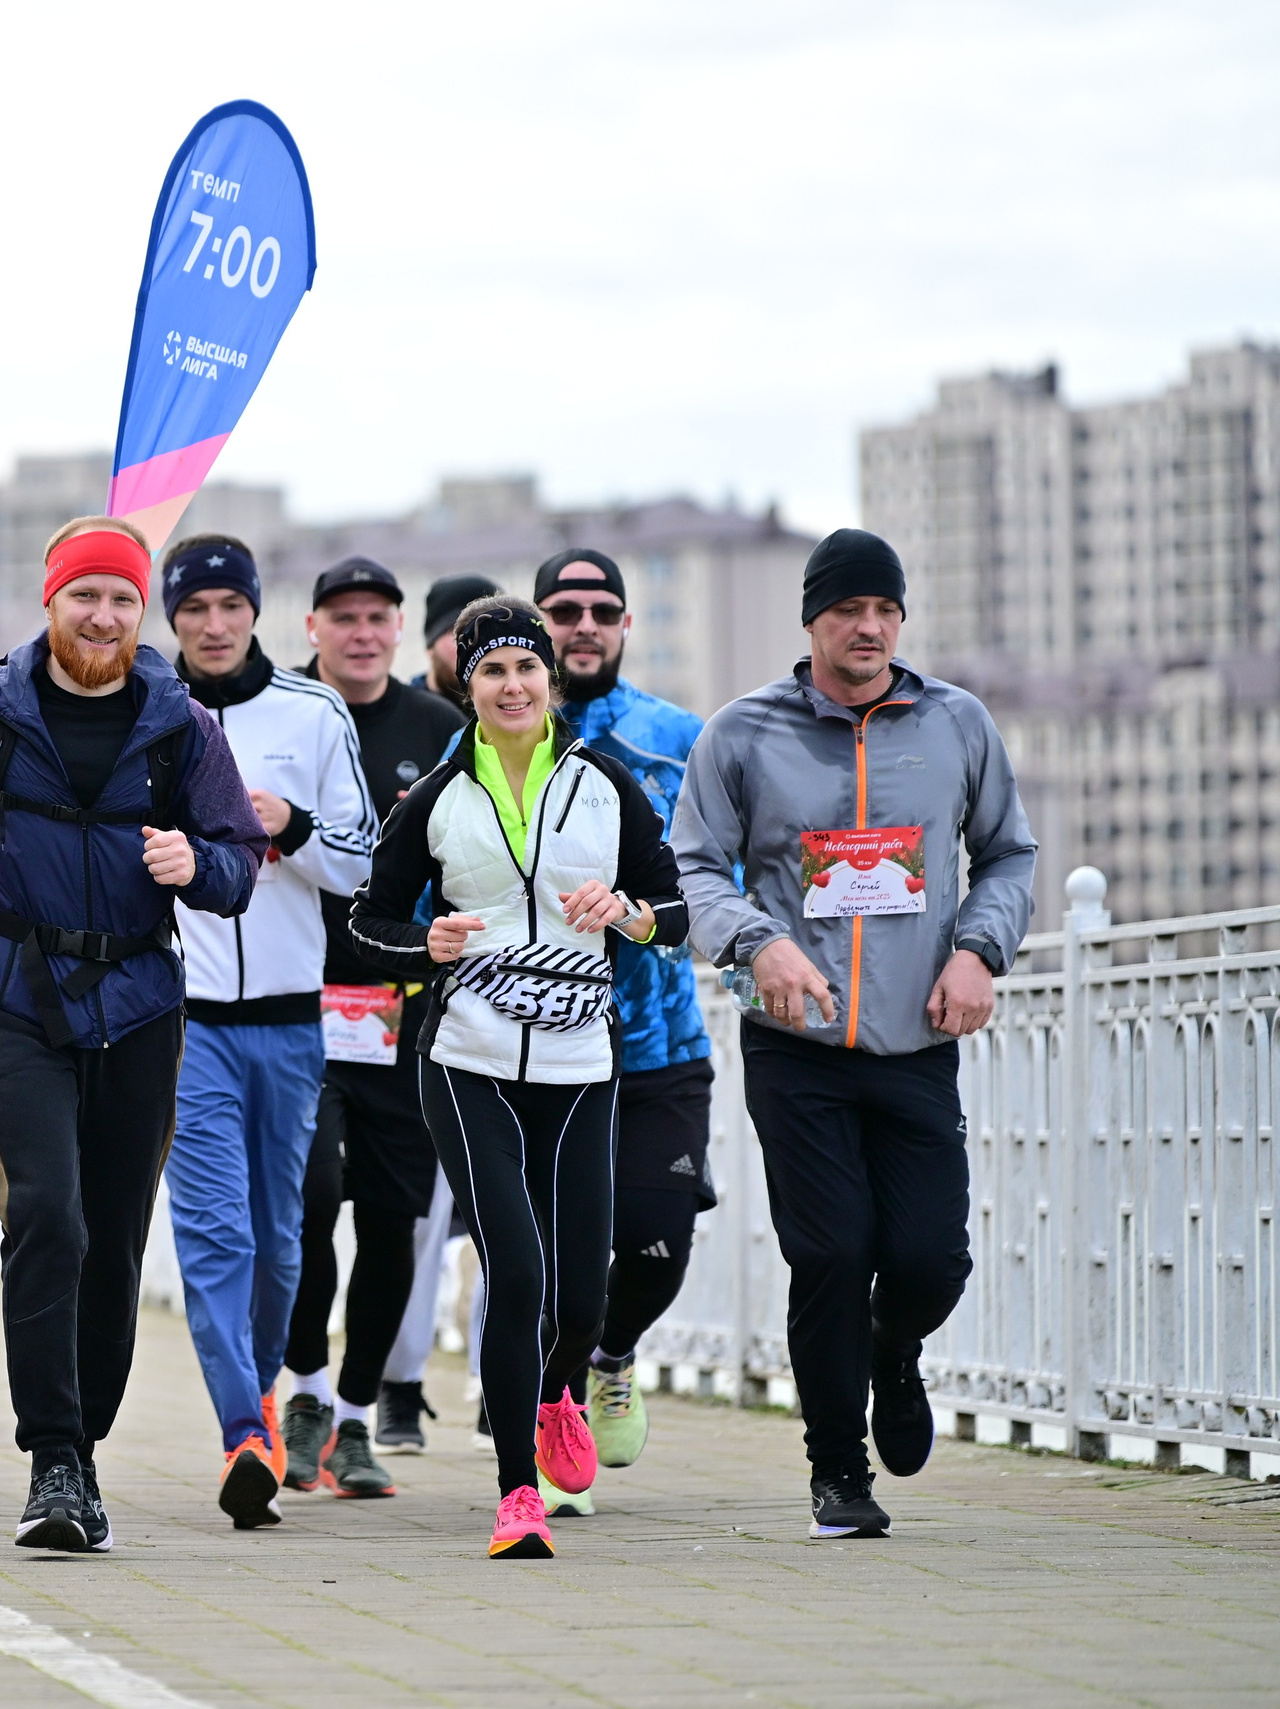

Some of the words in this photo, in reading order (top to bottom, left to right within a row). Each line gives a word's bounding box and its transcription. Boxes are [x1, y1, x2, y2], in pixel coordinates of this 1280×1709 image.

[183, 210, 281, 298] 7:00
[180, 355, 218, 381] ЛИГА
[185, 336, 248, 369] ВЫСШАЯ
[462, 636, 535, 684] REXCHI-SPORT
[824, 840, 879, 855] Новогодний
[879, 838, 903, 854] забег
